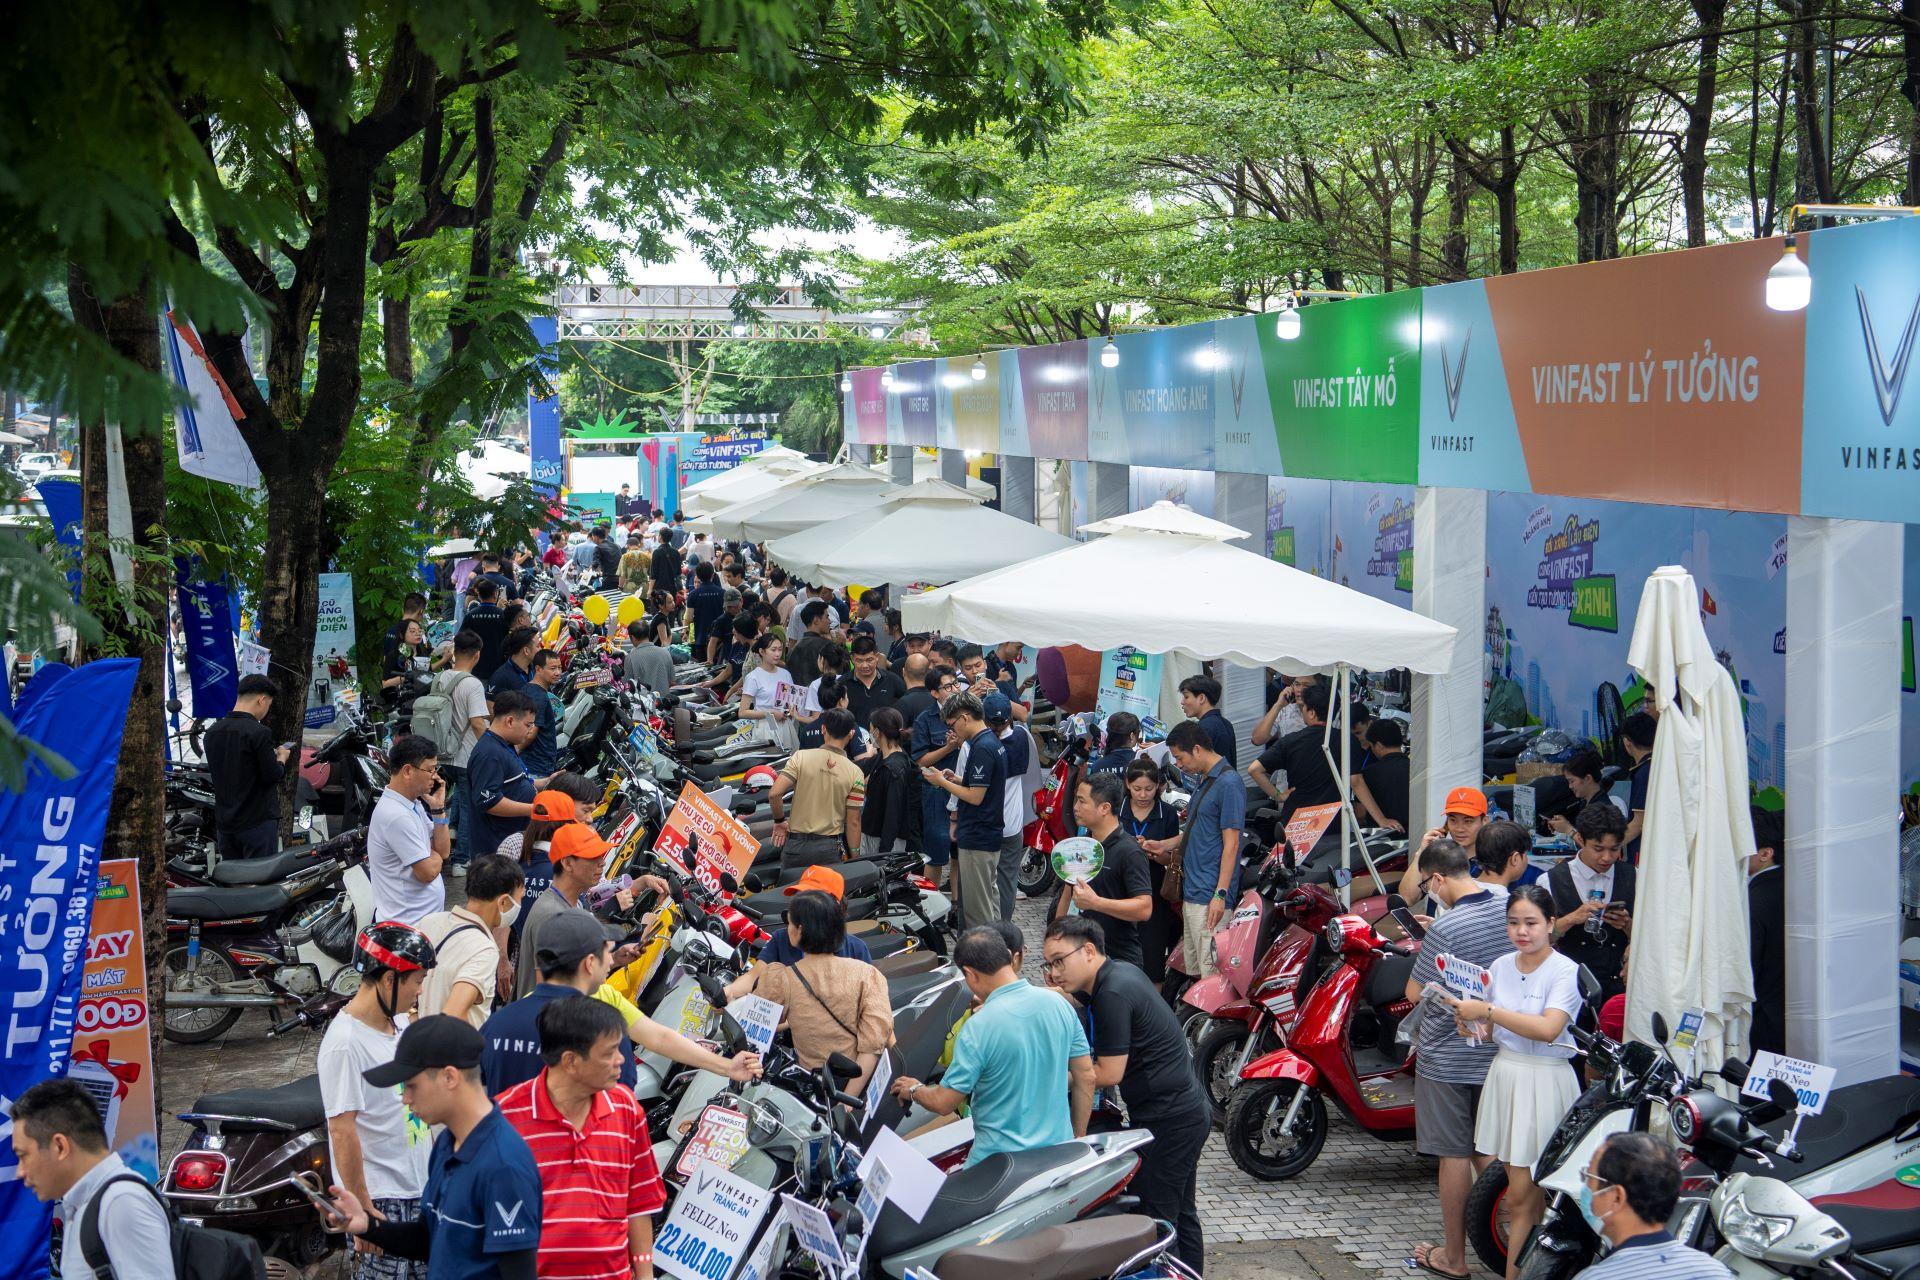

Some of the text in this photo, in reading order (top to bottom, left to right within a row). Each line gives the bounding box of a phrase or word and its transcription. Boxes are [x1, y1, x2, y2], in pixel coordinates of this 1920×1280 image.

[1293, 357, 1397, 408] VINFAST TÂY MỖ
[1531, 338, 1760, 404] VINFAST LÝ TƯỞNG
[1037, 392, 1061, 413] VINFAST
[1124, 381, 1208, 413] VINFAST HOÀNG ANH
[695, 412, 780, 425] VINFAST
[1225, 431, 1252, 444] VINFAST
[1431, 435, 1474, 452] VINFAST
[1841, 446, 1920, 470] VINFAS
[1575, 587, 1612, 618] XANH
[678, 799, 714, 835] THU XE CŨ
[695, 795, 756, 855] VINFAST LÝ TƯỞNG
[703, 839, 716, 855] MỚI
[713, 851, 728, 867] GIÁ
[724, 862, 738, 878] CAO
[5, 796, 76, 1060] TƯỞNG
[86, 968, 126, 988] MÁT
[1451, 961, 1480, 976] VINFAST
[1472, 982, 1483, 994] AN
[1784, 1059, 1817, 1070] VINFAST
[1766, 1068, 1811, 1088] EVO Neo
[717, 1115, 741, 1127] VINFAST
[712, 1192, 750, 1219] TRÀNG AN
[715, 1178, 760, 1208] VINFAST
[493, 1227, 526, 1237] VINFAST
[680, 1201, 739, 1243] FELIZ Neo
[654, 1223, 733, 1280] 22.400.000
